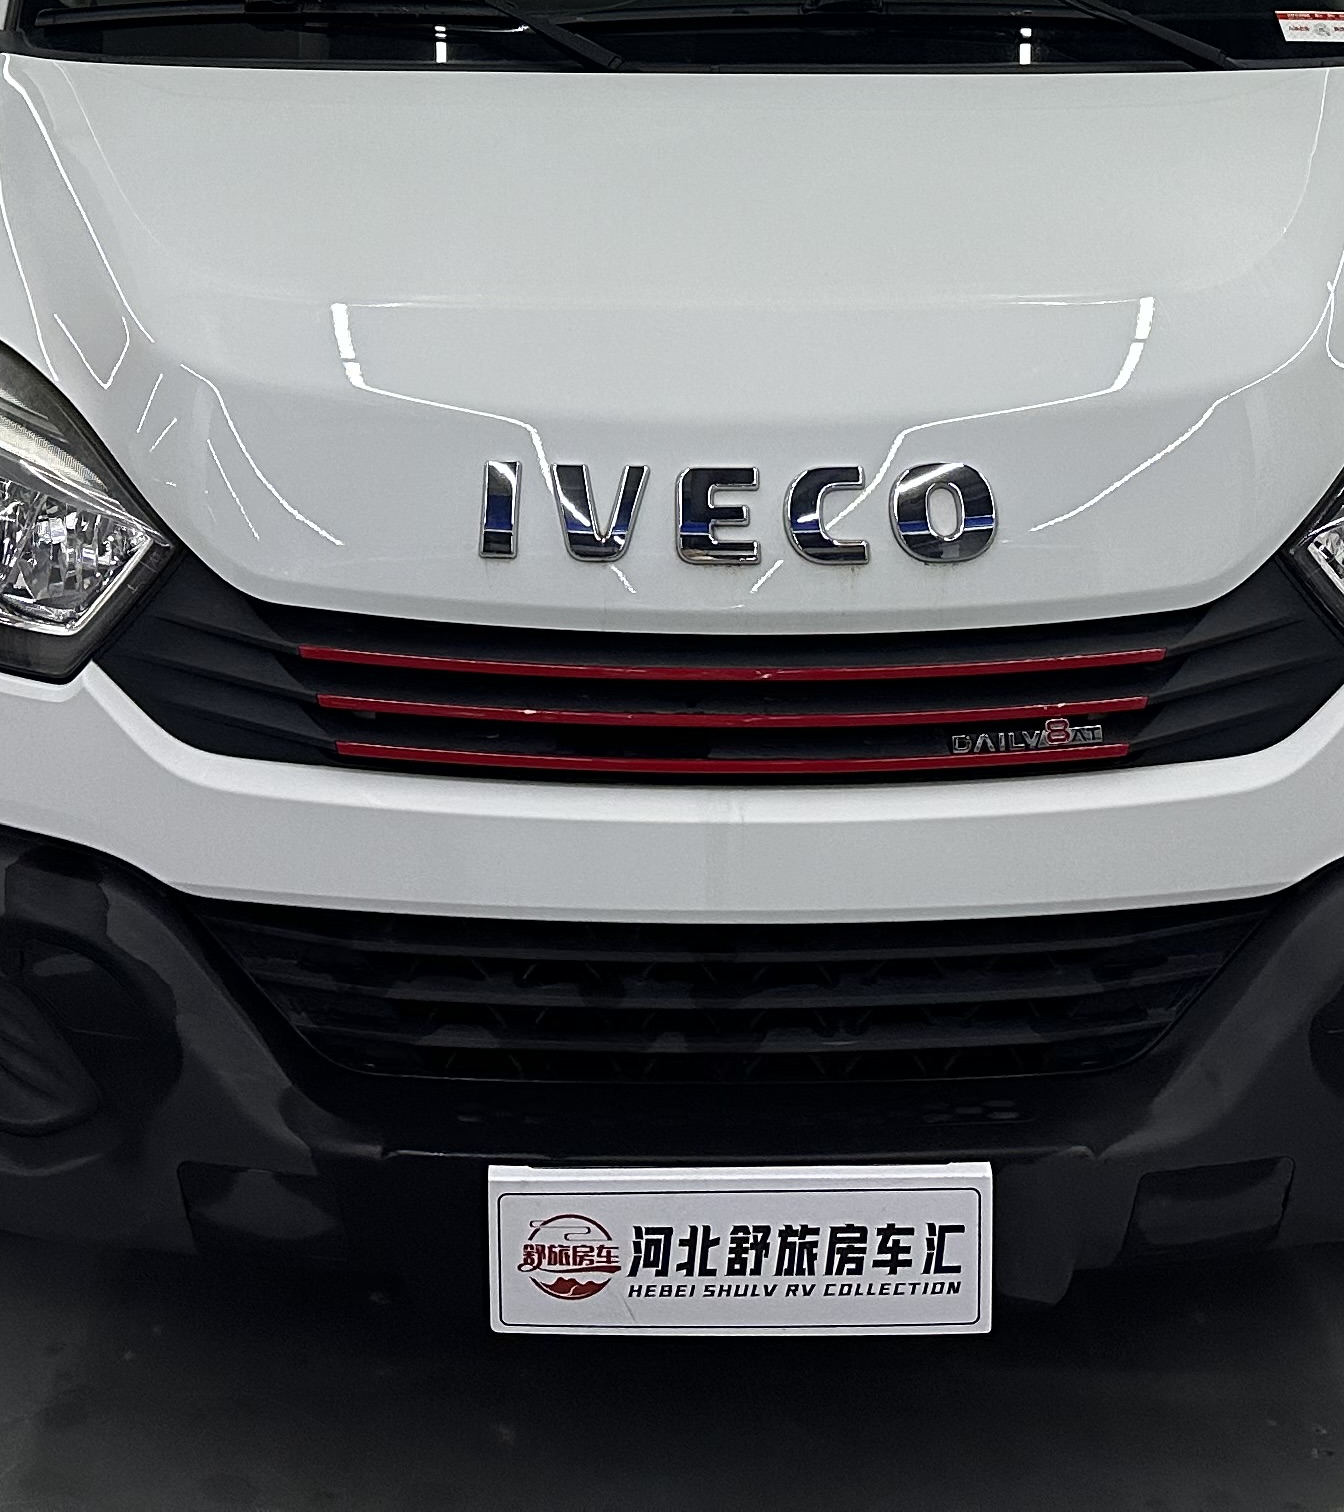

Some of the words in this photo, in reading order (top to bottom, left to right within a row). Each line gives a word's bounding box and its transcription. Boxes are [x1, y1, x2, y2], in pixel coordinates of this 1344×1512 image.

[478, 459, 999, 567] IVECO
[951, 730, 1041, 754] DAILY
[518, 1243, 621, 1270] 舒旅房车
[626, 1222, 967, 1279] 河北舒旅房车汇
[627, 1283, 697, 1299] HEBEI
[702, 1283, 777, 1298] SHULV
[784, 1283, 816, 1298] RV
[822, 1281, 963, 1298] COLLECTION
